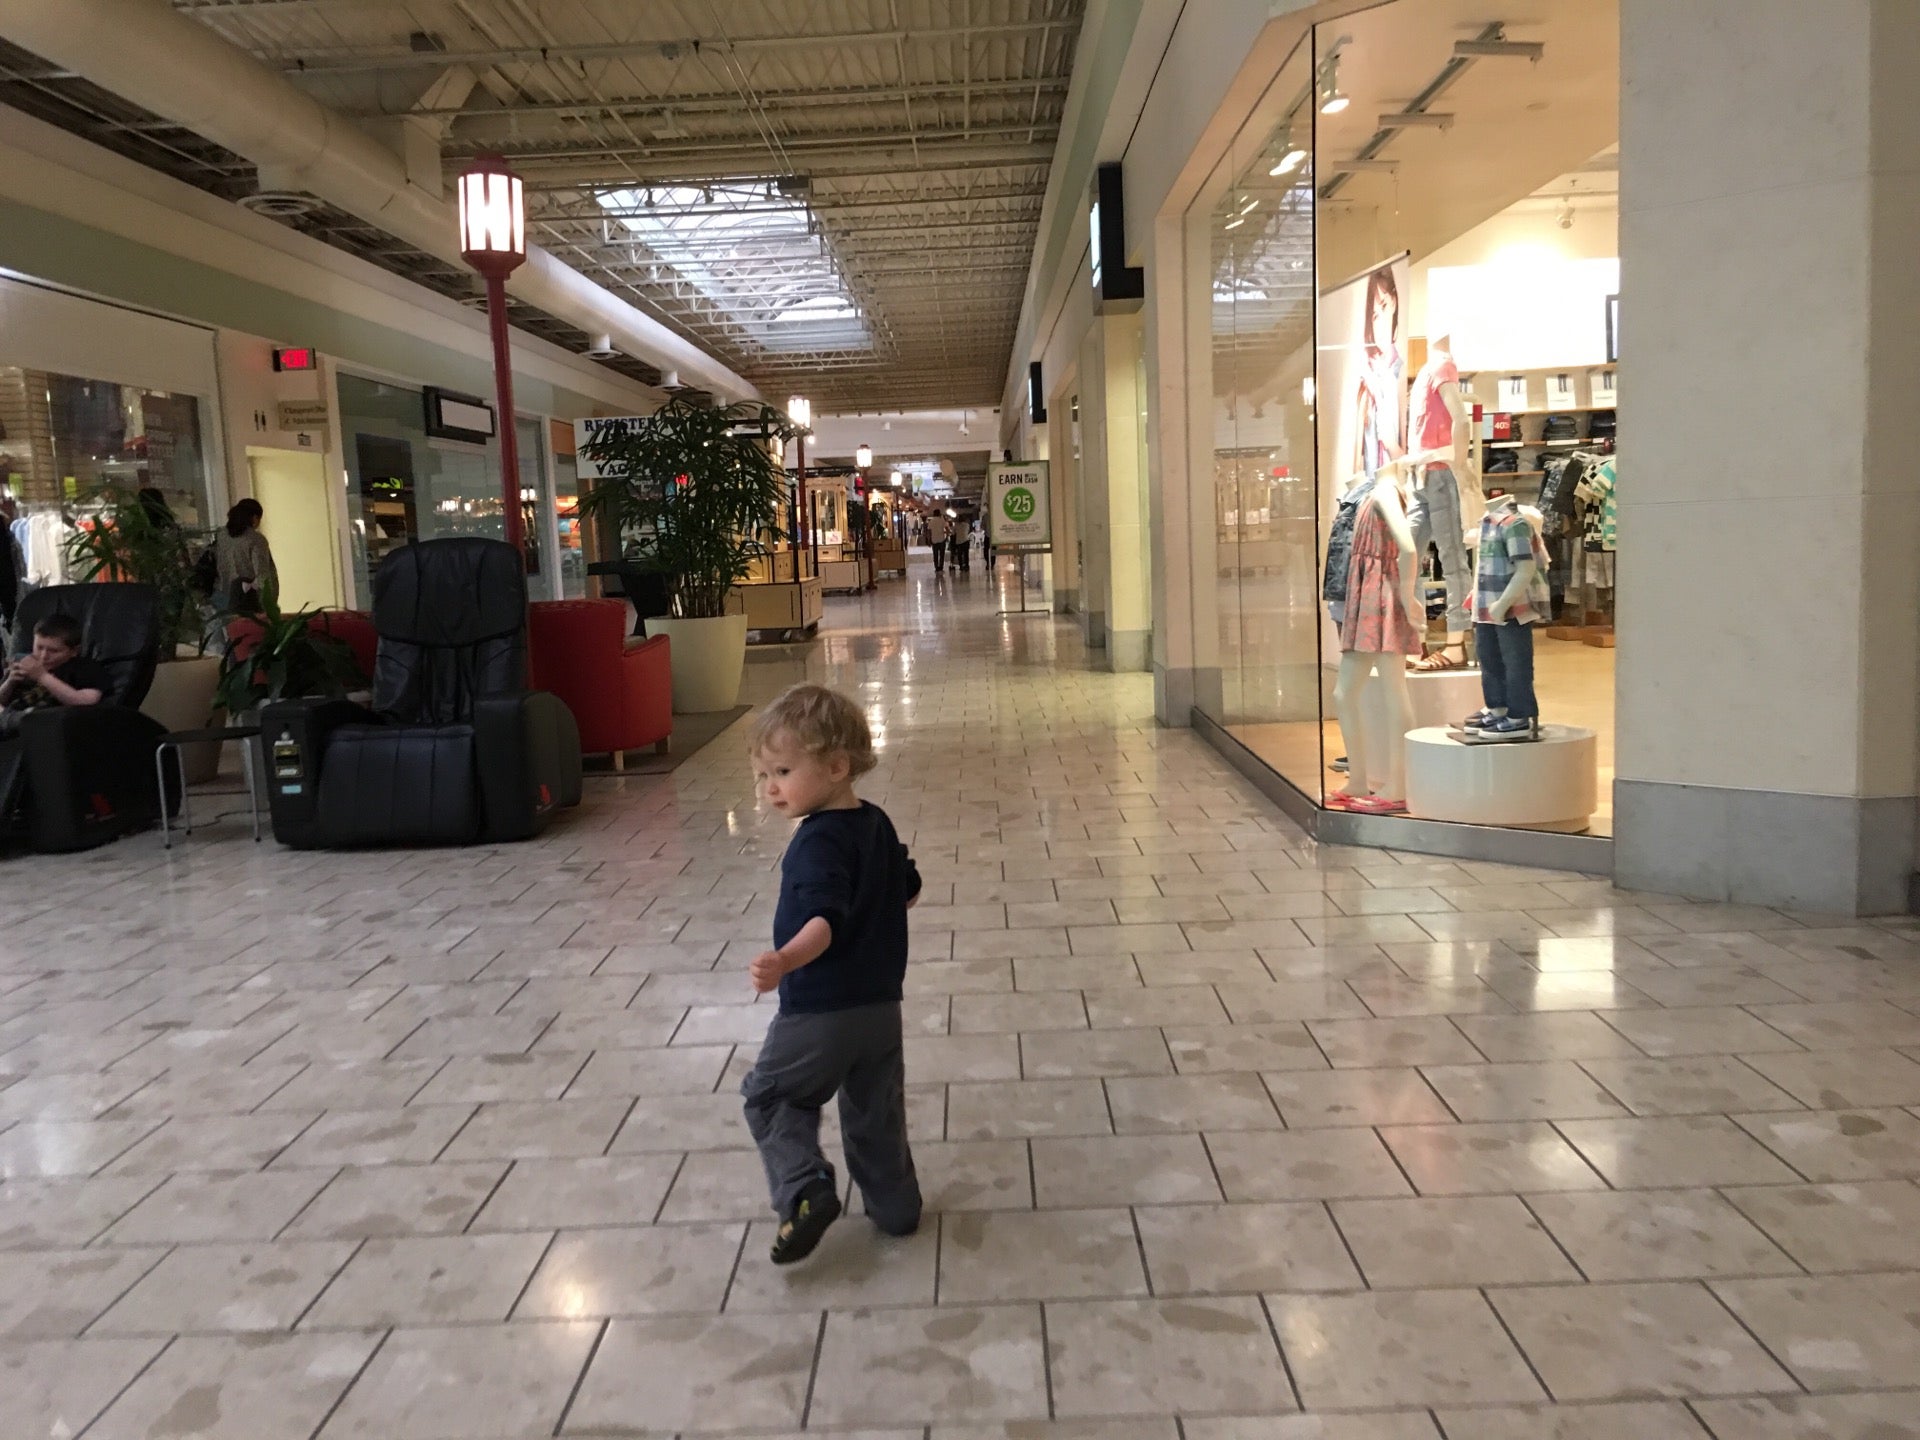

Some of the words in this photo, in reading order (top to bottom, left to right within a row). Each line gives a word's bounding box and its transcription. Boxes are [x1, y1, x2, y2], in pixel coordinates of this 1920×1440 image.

[584, 417, 654, 431] REGISTE
[999, 473, 1023, 485] EARN
[1007, 495, 1031, 513] $25
